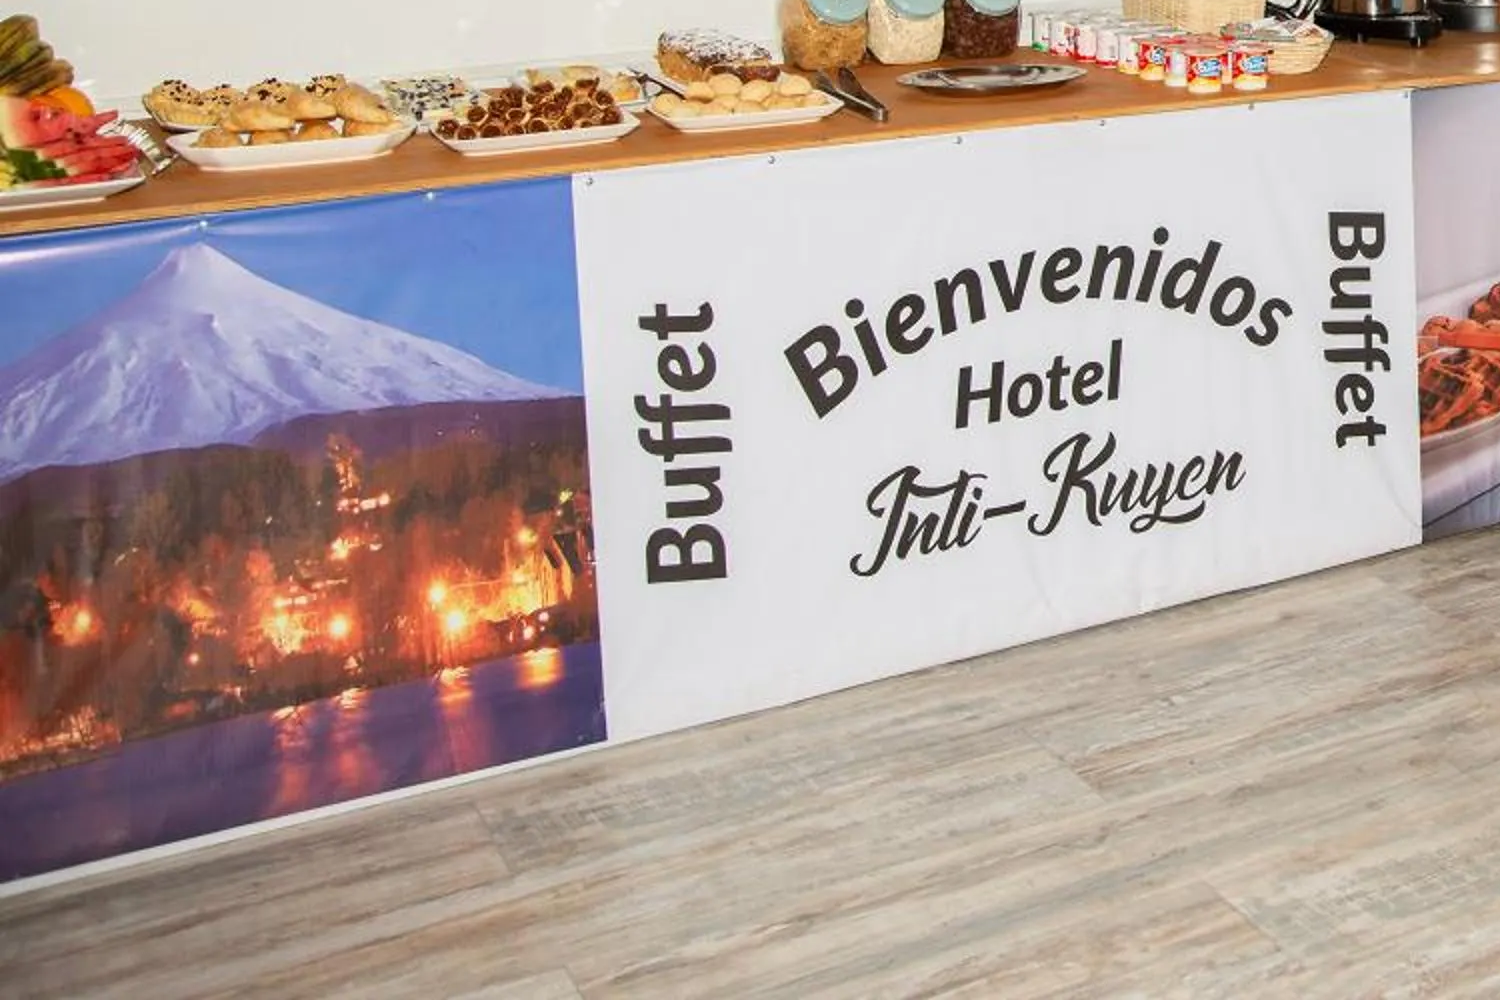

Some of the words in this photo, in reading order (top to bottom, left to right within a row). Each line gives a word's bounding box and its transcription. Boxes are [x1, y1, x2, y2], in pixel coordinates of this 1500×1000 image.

[784, 227, 1292, 418] Bienvenidos
[956, 339, 1122, 428] Hotel
[1322, 212, 1390, 448] Buffet
[634, 302, 732, 584] Buffet
